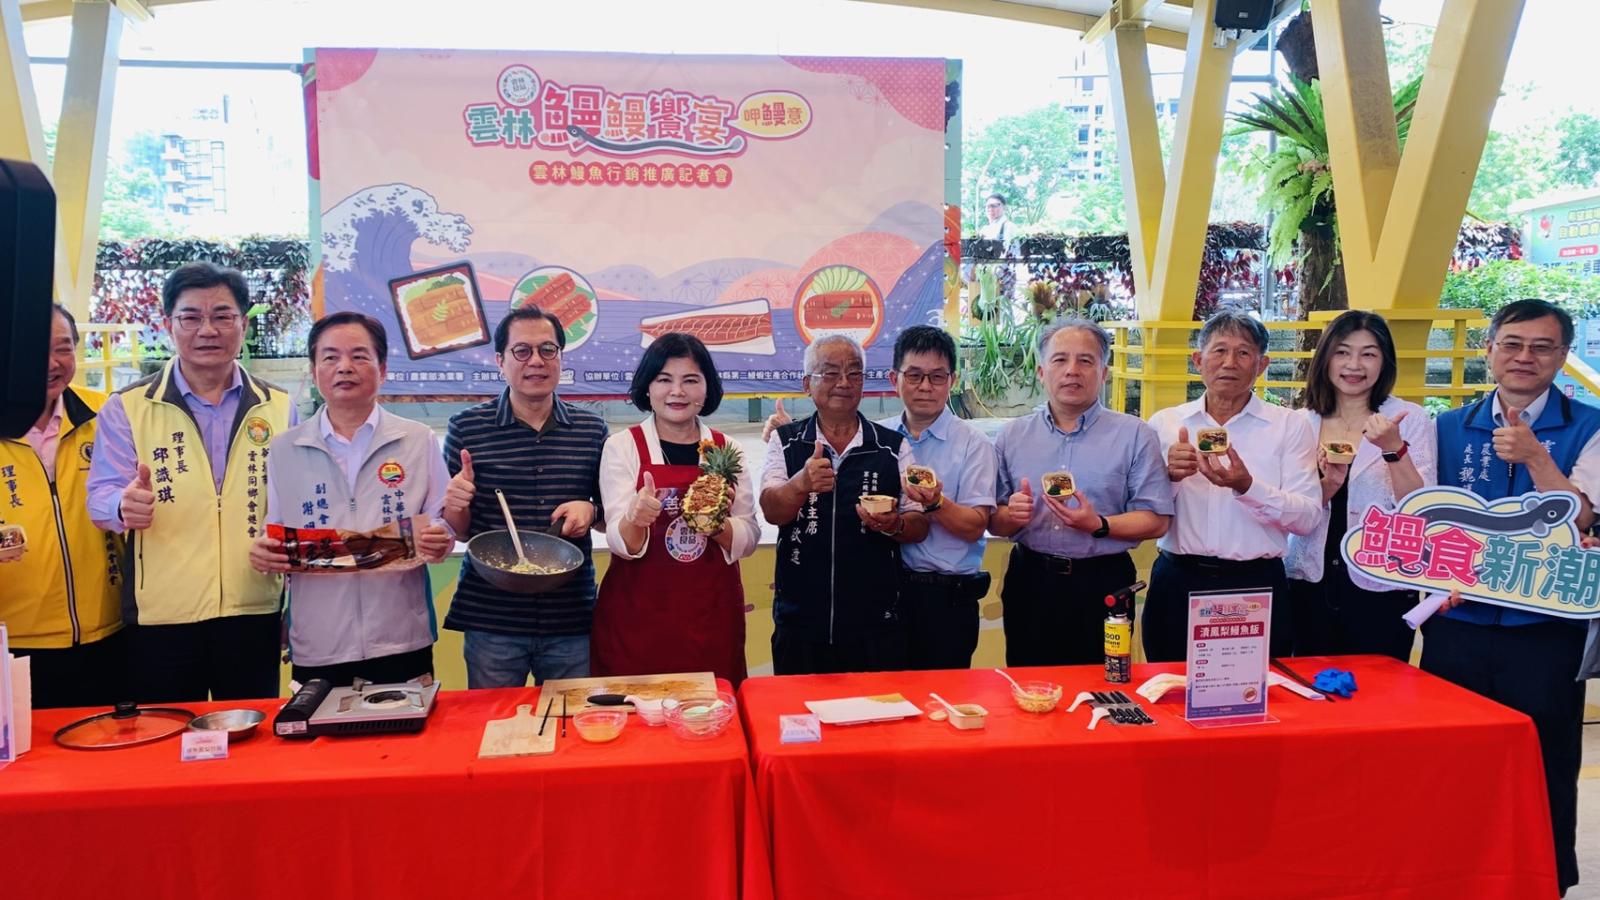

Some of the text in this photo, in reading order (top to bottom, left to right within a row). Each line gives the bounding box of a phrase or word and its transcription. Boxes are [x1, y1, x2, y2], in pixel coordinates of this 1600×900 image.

[744, 102, 803, 126] 呷鰻意
[533, 164, 728, 182] 雲林鰻魚行銷推廣記者會
[172, 431, 188, 474] 理事長
[1, 465, 23, 508] 理事長
[1354, 506, 1600, 607] 鰻食新潮
